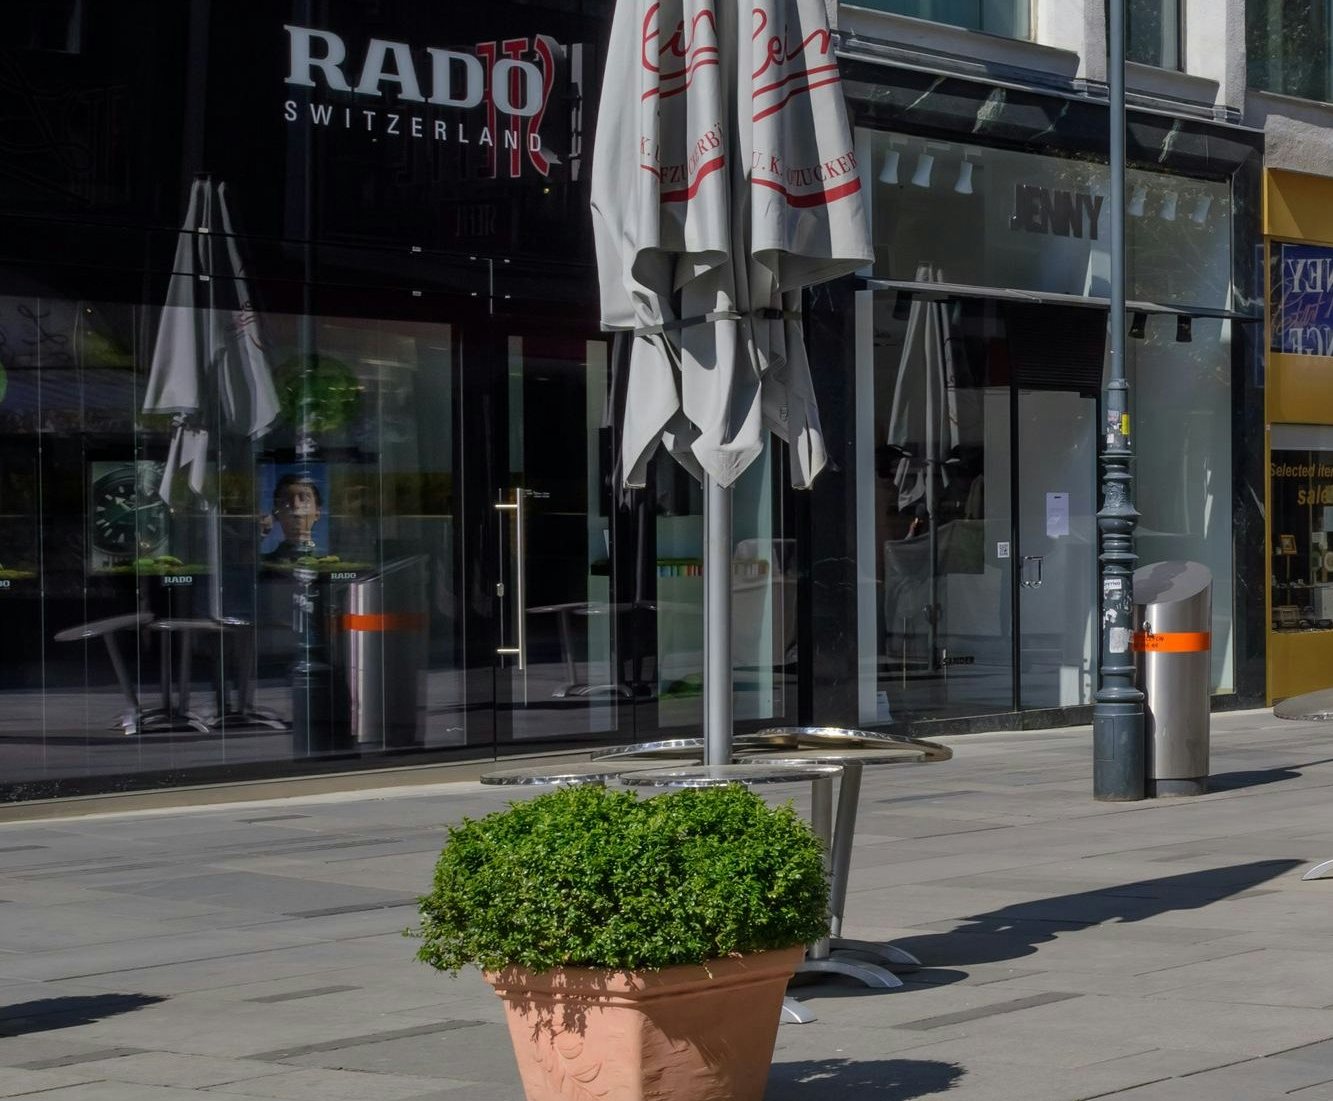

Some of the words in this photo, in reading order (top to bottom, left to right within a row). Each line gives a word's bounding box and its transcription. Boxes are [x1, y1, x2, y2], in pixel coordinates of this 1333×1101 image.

[283, 23, 544, 118] RADO
[283, 99, 542, 152] SWITZERLAND
[1010, 183, 1104, 240] JENNY
[1271, 463, 1315, 478] Selected
[1297, 485, 1328, 506] sale
[164, 575, 193, 584] RADO
